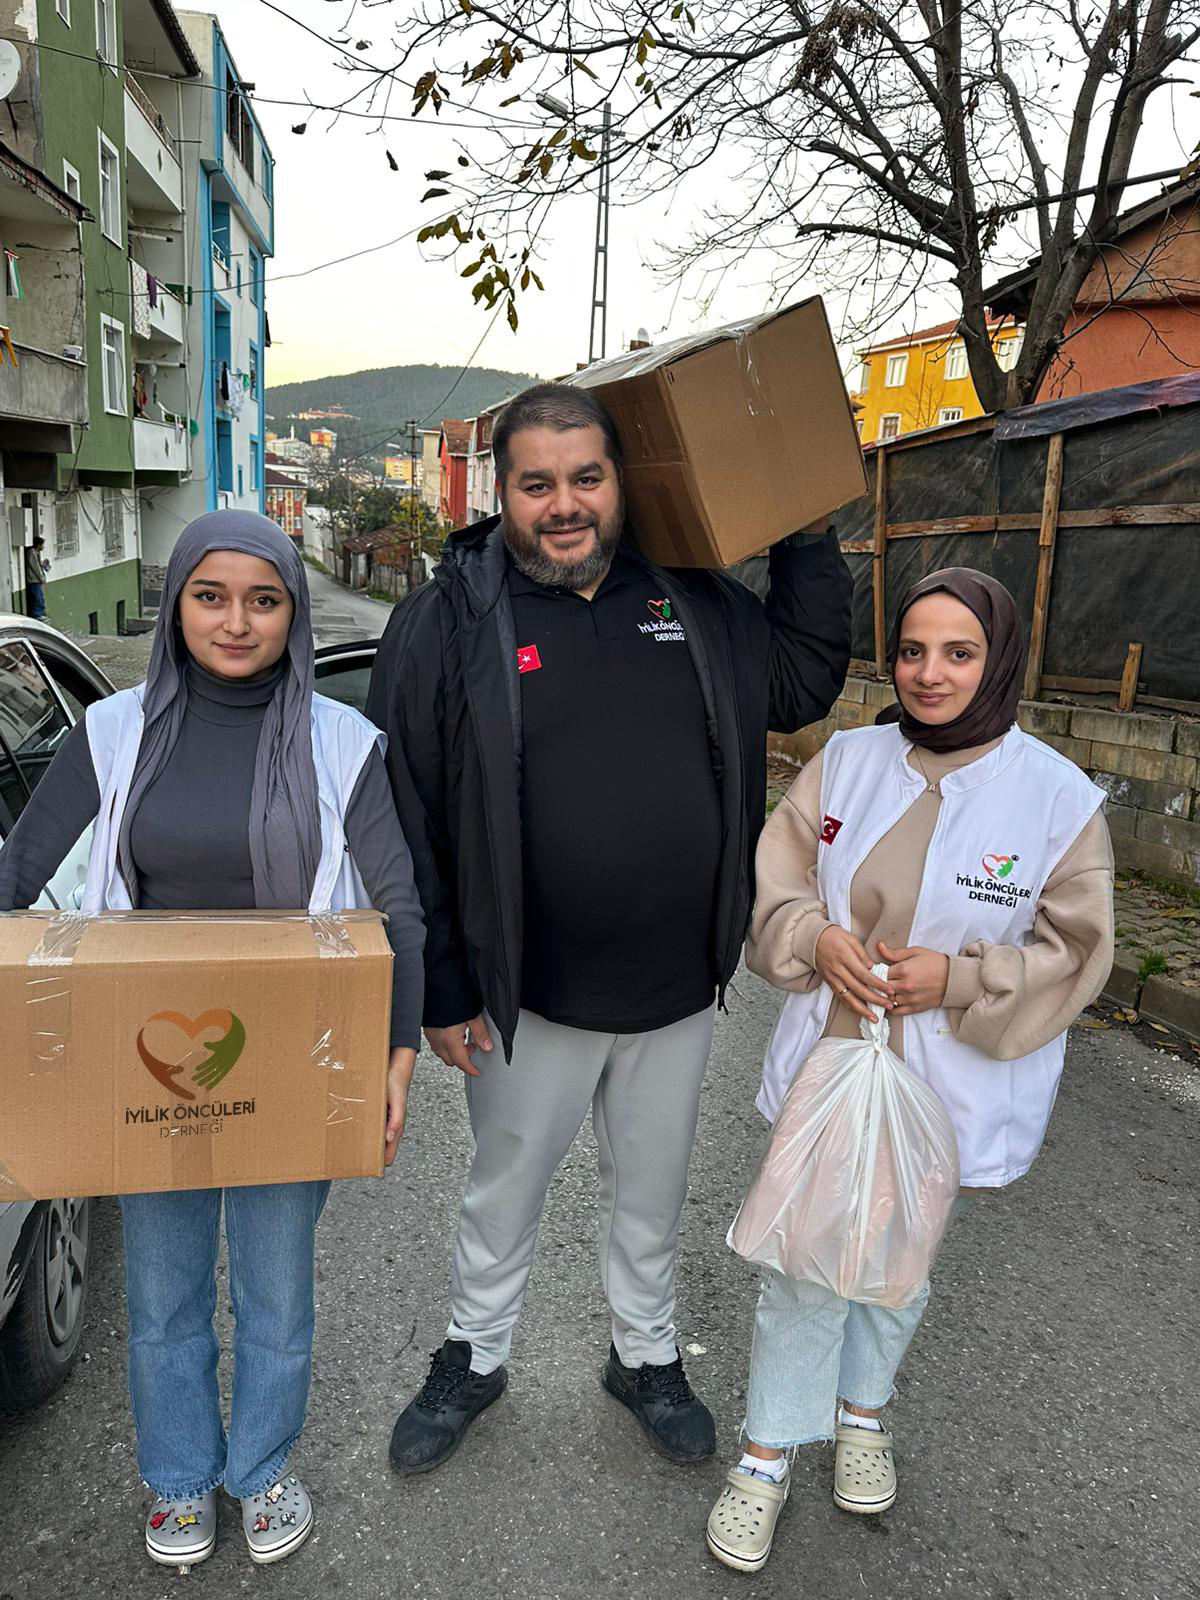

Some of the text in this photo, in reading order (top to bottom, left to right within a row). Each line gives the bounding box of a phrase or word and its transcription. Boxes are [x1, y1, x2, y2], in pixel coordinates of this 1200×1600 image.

[956, 873, 984, 889] İYİLİK
[968, 890, 1017, 908] DERNEĞİ
[125, 1098, 255, 1124] İYİLİK ÖNCÜLERİ
